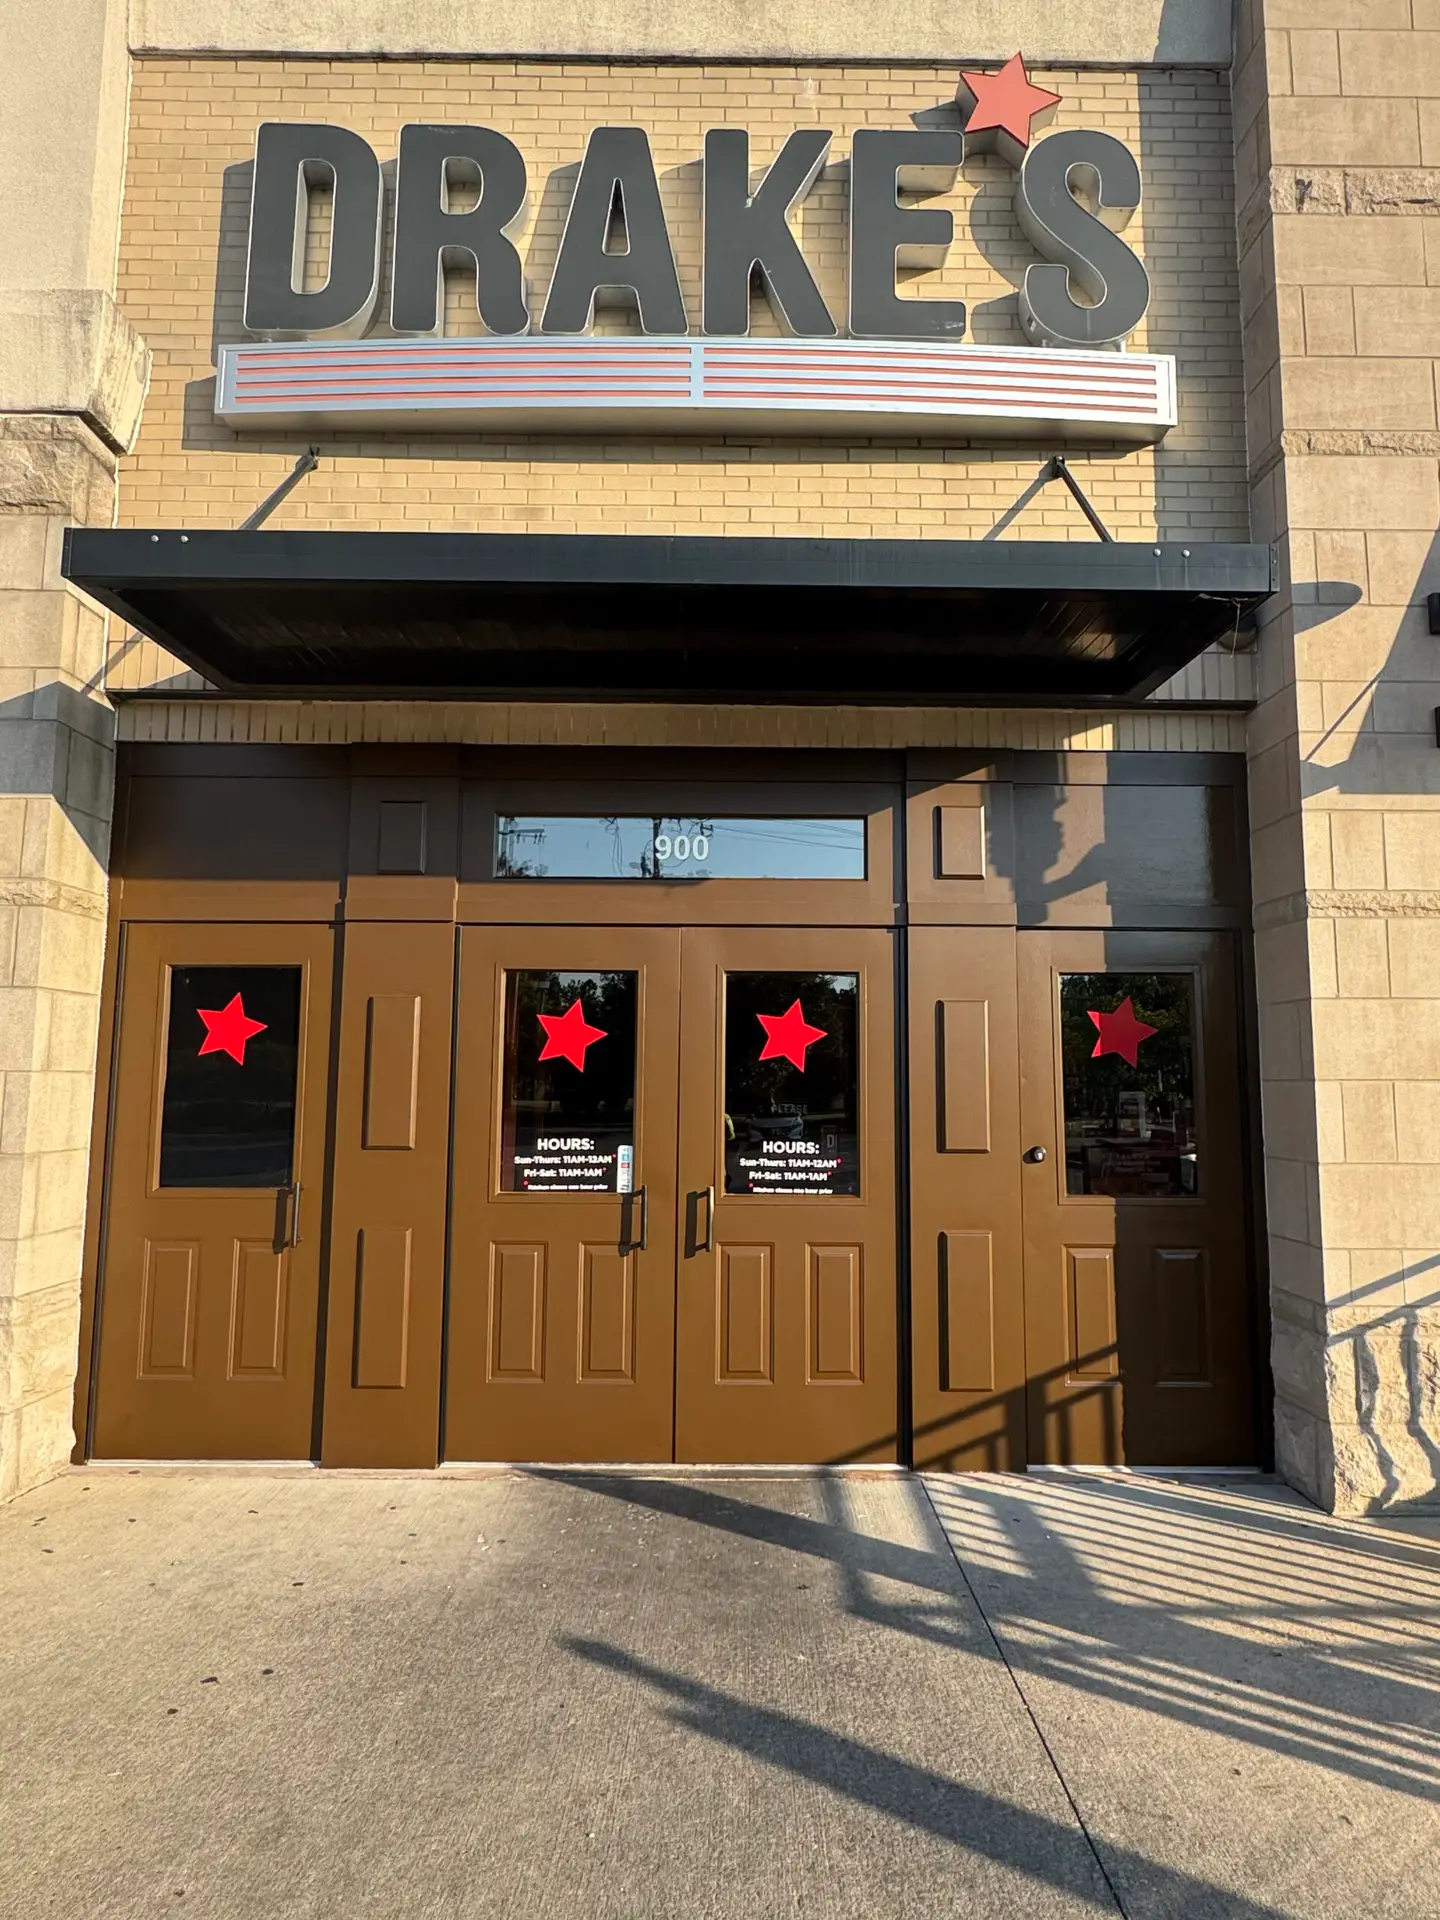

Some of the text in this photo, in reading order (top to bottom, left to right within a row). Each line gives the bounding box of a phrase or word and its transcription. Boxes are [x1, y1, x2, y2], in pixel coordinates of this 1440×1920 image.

[654, 834, 710, 860] 900
[537, 1137, 595, 1151] HOURS:
[762, 1140, 820, 1155] HOURS:
[514, 1155, 612, 1165] Sun-Thurs: 11AM-12AM
[739, 1158, 837, 1169] Sun-Thurs: 11AM-12AM
[524, 1168, 603, 1178] Fri-Sat: 11AM-1AM
[749, 1171, 828, 1181] Fri-Sat: 11AM-1AM
